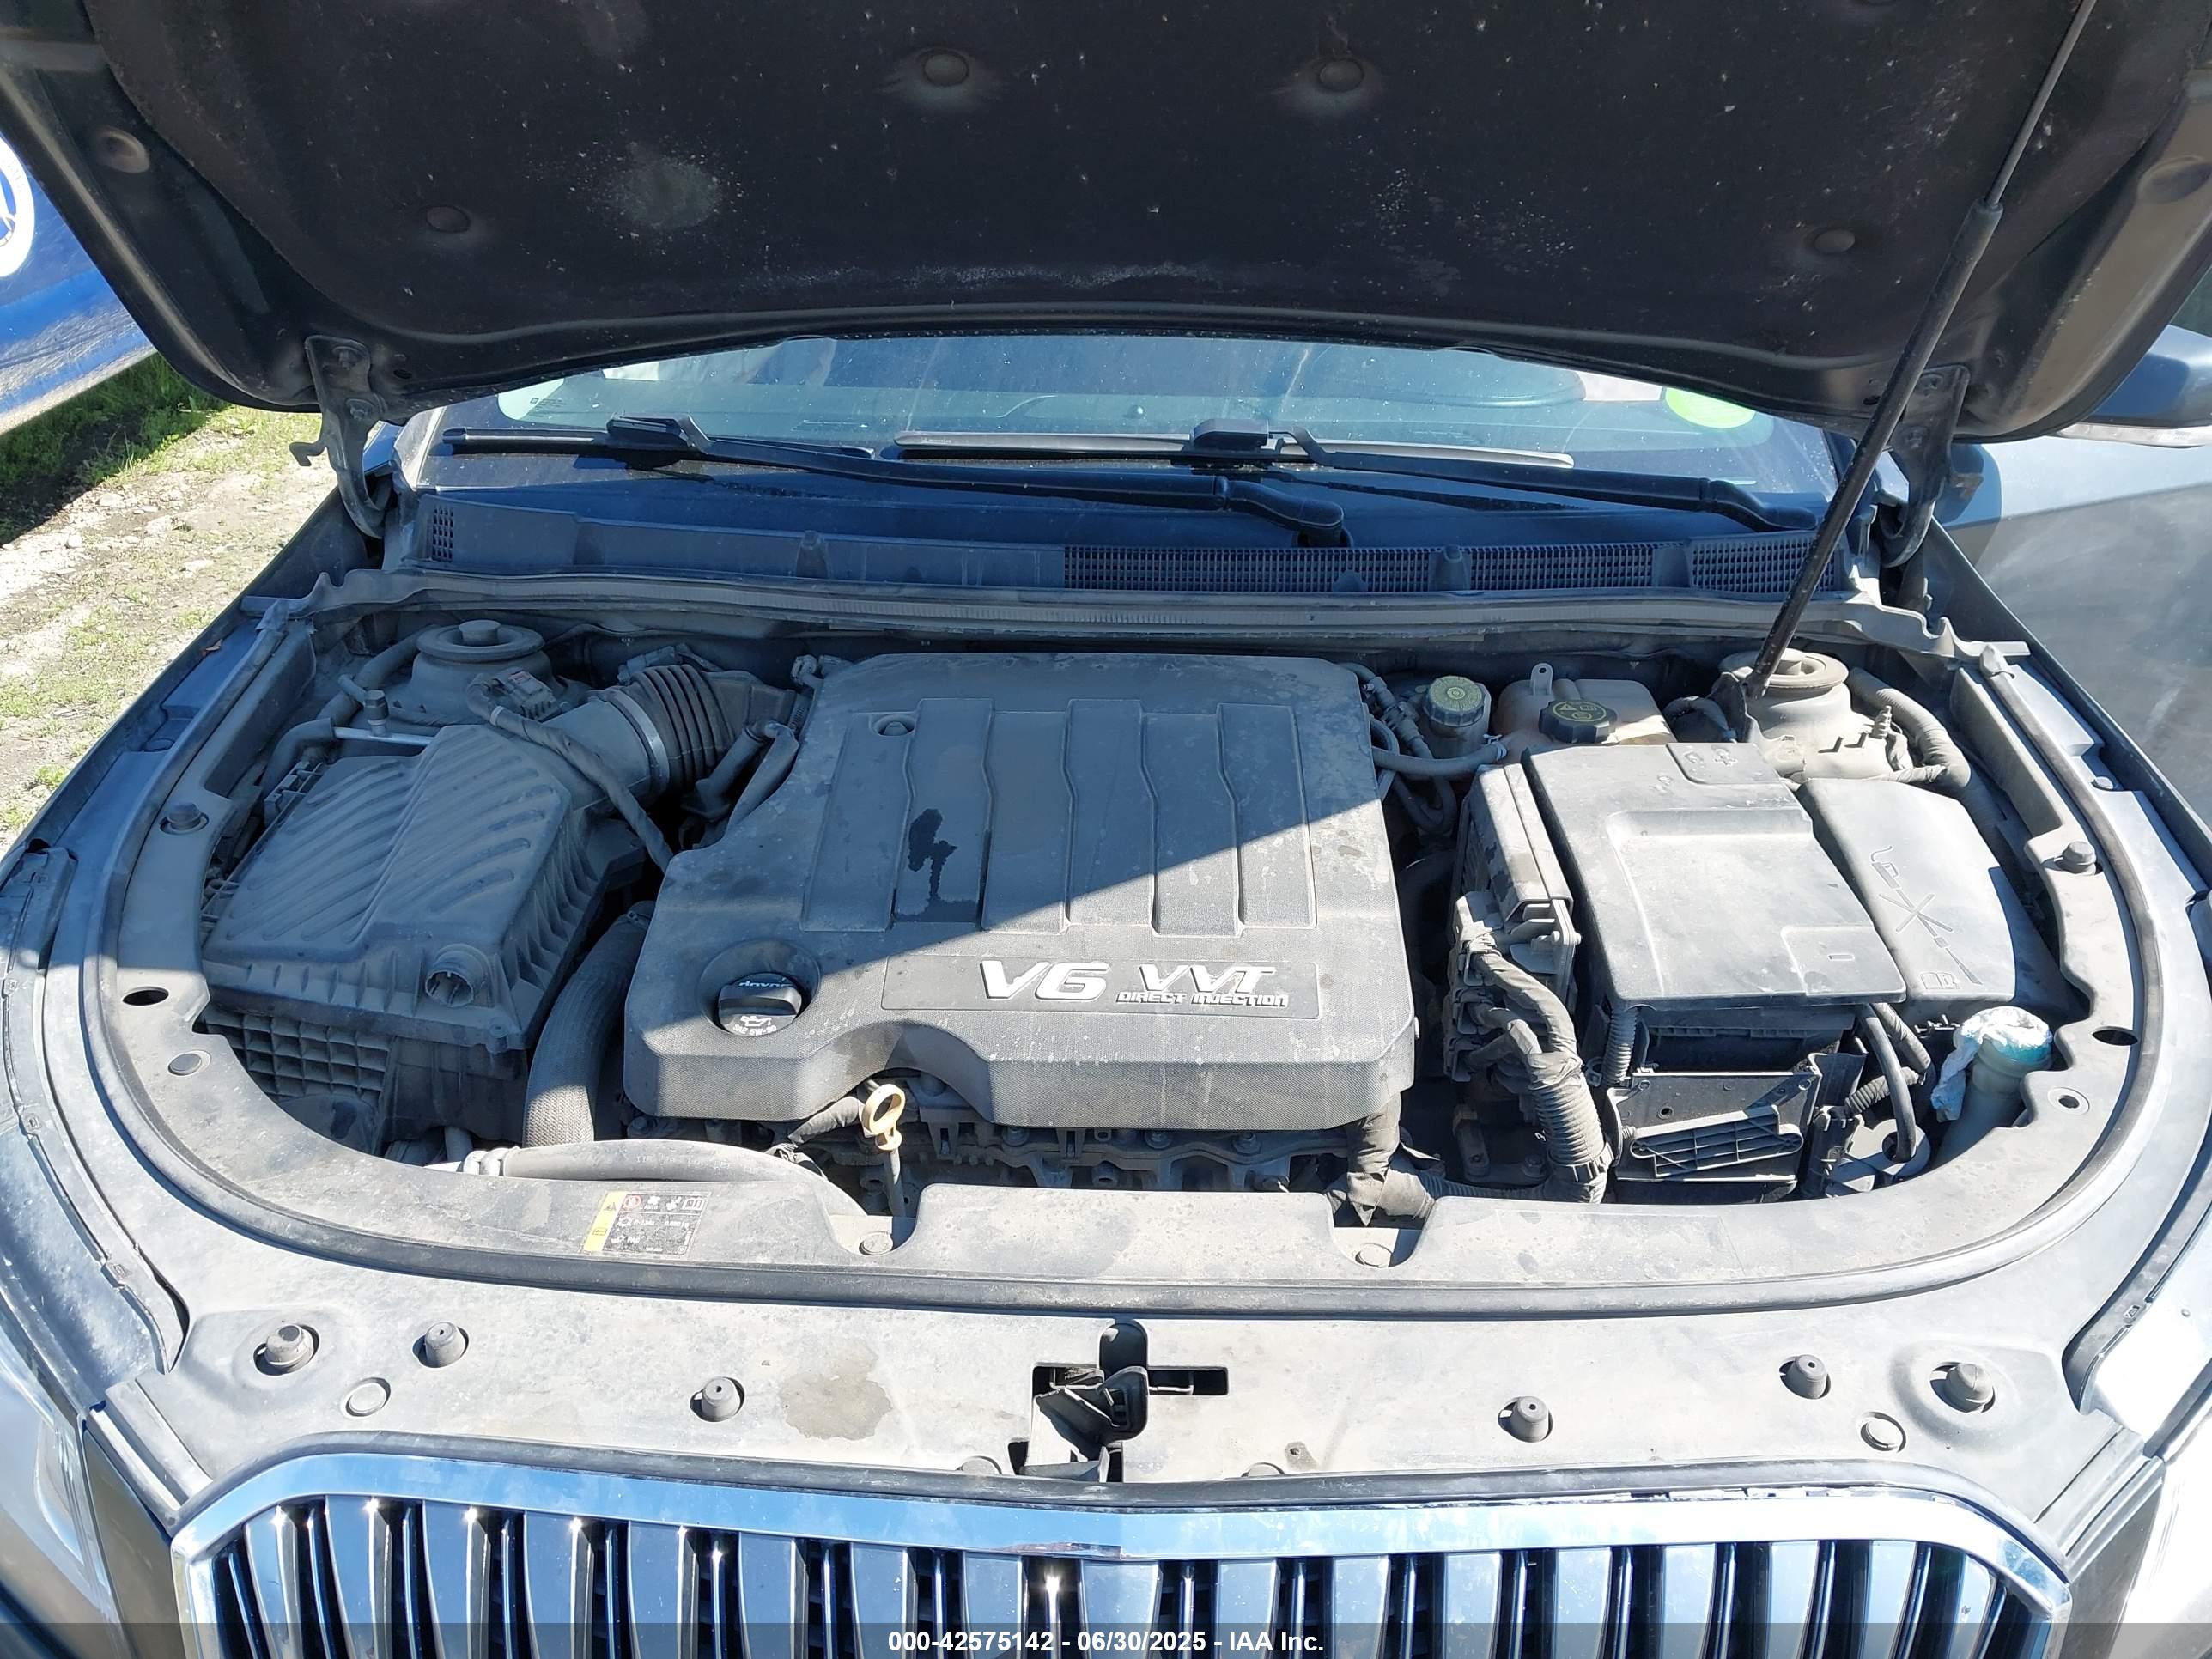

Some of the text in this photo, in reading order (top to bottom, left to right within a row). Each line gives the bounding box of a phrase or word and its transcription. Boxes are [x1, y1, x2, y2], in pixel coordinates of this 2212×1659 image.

[979, 960, 1276, 1001] V6 VVT
[1115, 991, 1289, 1008] DIRECT INJECTION
[733, 1024, 748, 1035] SAE
